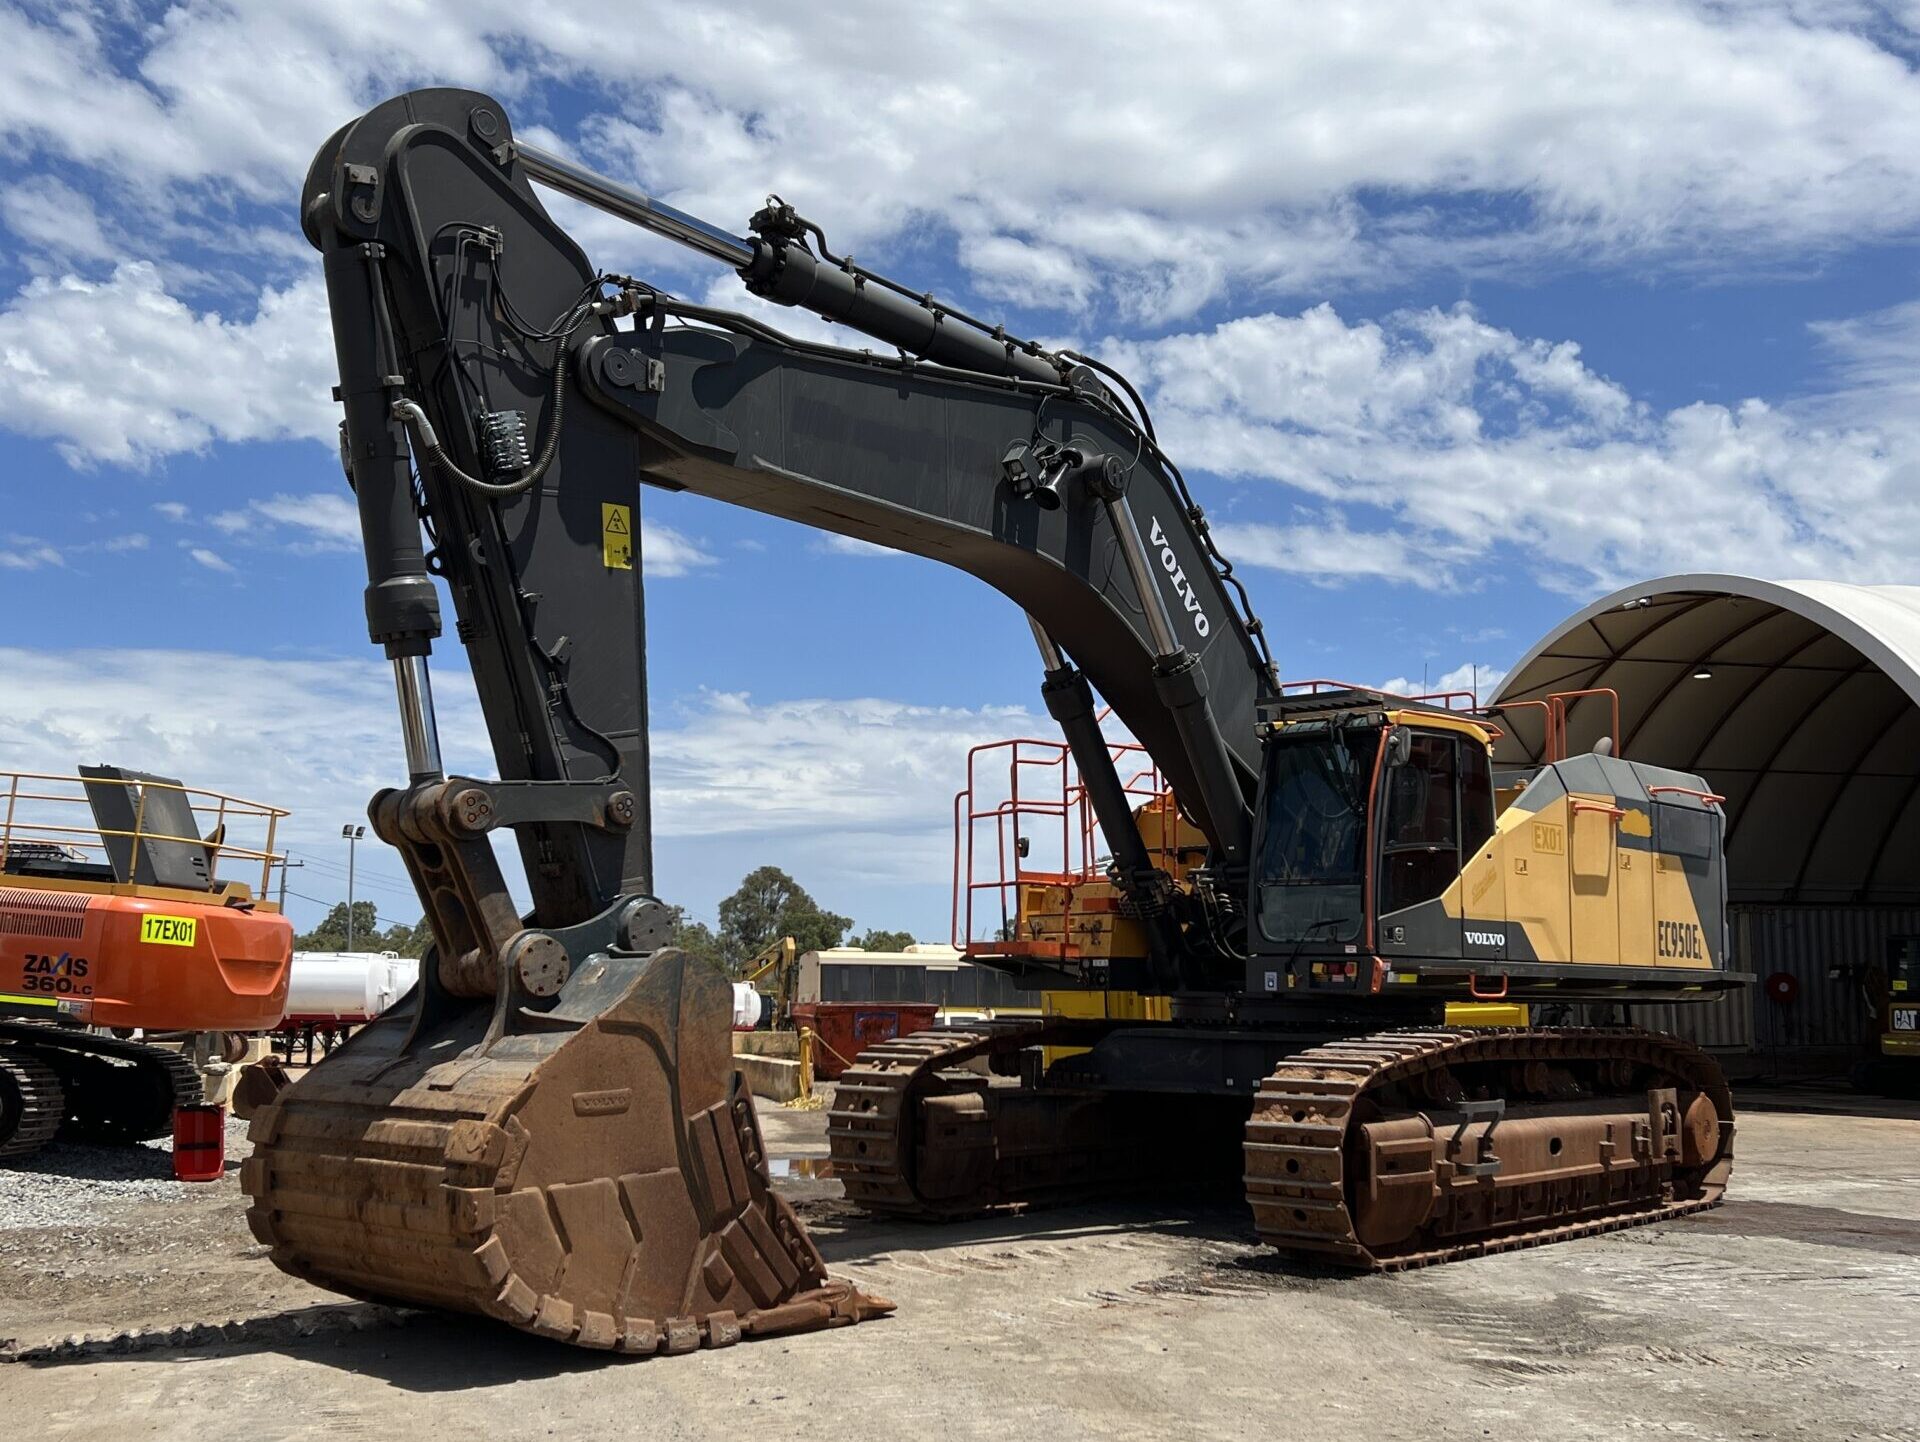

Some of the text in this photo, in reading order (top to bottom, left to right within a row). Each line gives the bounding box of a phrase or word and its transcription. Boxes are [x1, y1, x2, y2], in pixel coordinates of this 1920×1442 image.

[1150, 516, 1209, 637] VOLVO
[1534, 825, 1562, 851] EX01
[145, 918, 194, 942] 17EX01
[1464, 931, 1505, 946] VOLVO
[23, 952, 89, 977] ZAXIS
[1894, 1010, 1917, 1030] CAT
